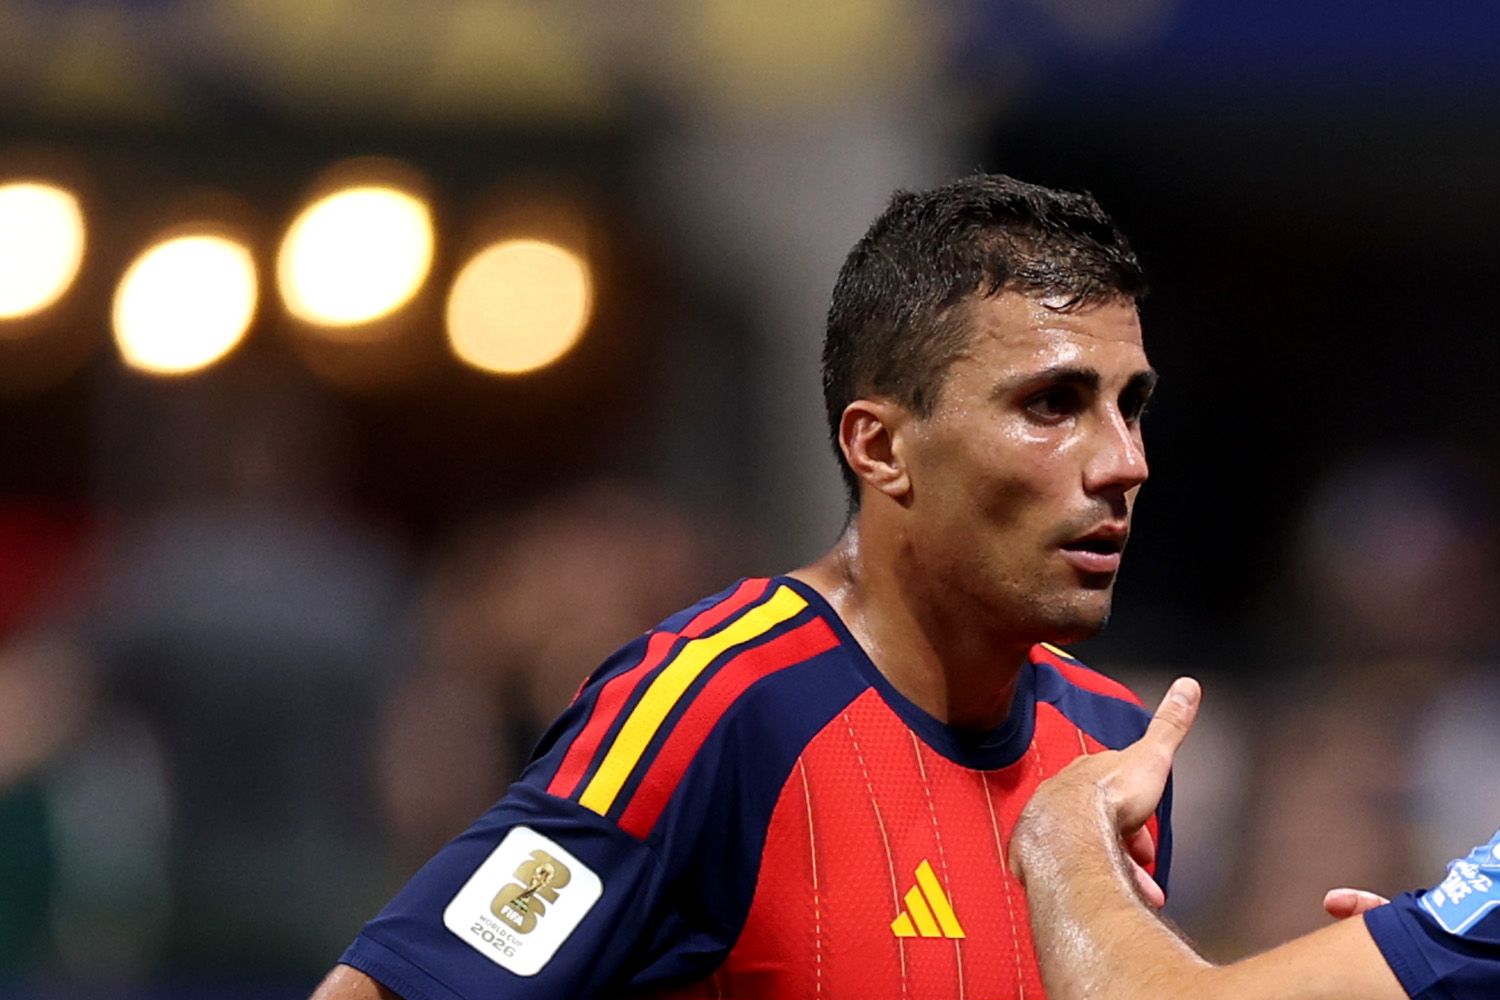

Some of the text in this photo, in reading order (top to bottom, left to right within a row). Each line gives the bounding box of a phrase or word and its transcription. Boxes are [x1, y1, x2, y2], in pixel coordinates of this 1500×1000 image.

[470, 923, 516, 958] 2026
[479, 915, 523, 947] WORLD CUP
